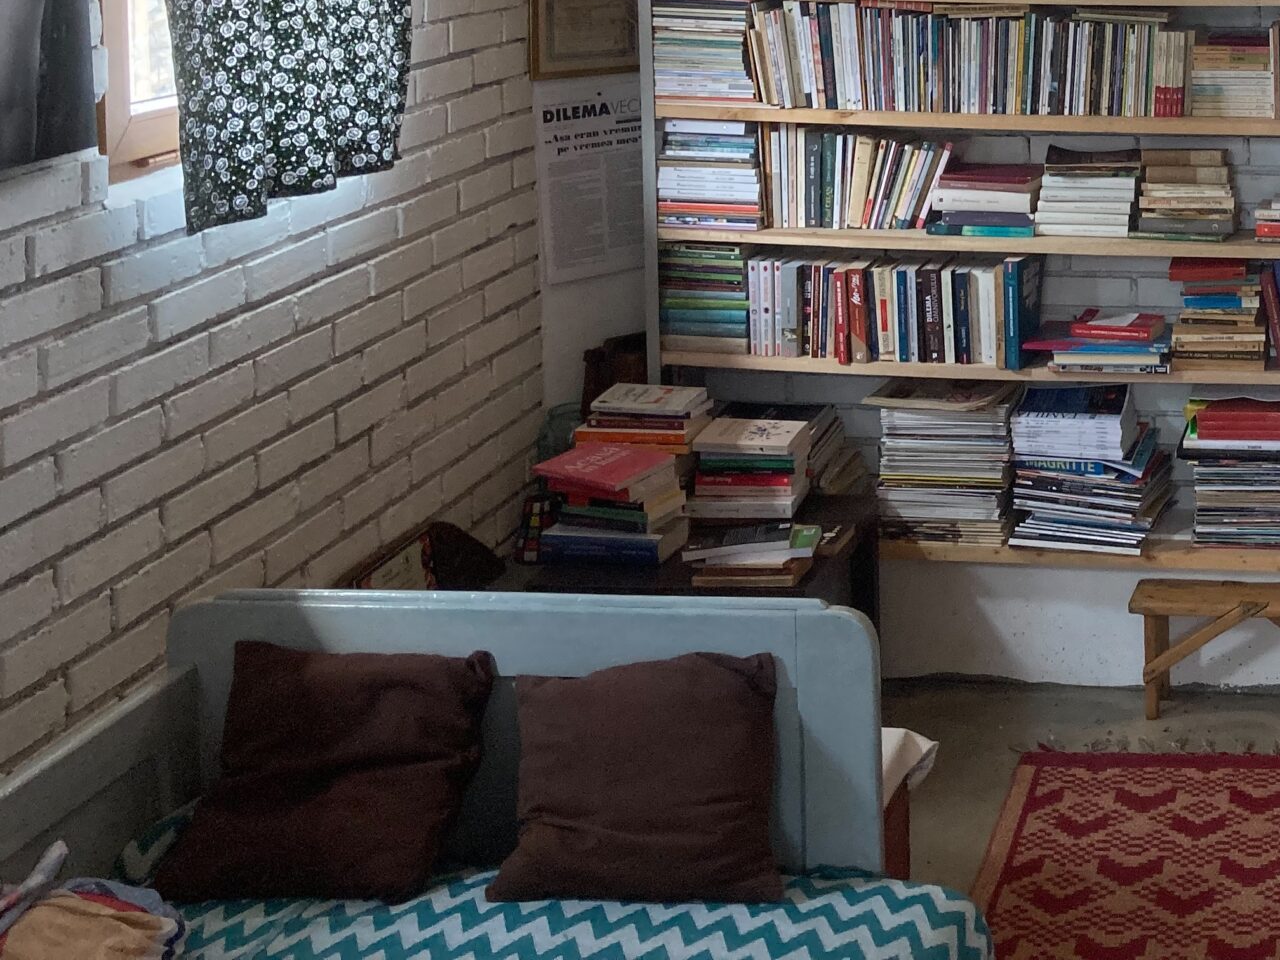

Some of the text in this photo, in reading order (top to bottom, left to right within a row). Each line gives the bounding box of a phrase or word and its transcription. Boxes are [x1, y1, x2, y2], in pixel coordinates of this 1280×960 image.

[542, 98, 642, 124] DILEMA VEC
[557, 145, 570, 156] pe
[822, 185, 834, 209] CELAN
[925, 295, 933, 323] DILEMA
[930, 273, 940, 323] OMNIVORULUI
[1025, 460, 1097, 473] MAGRITTE
